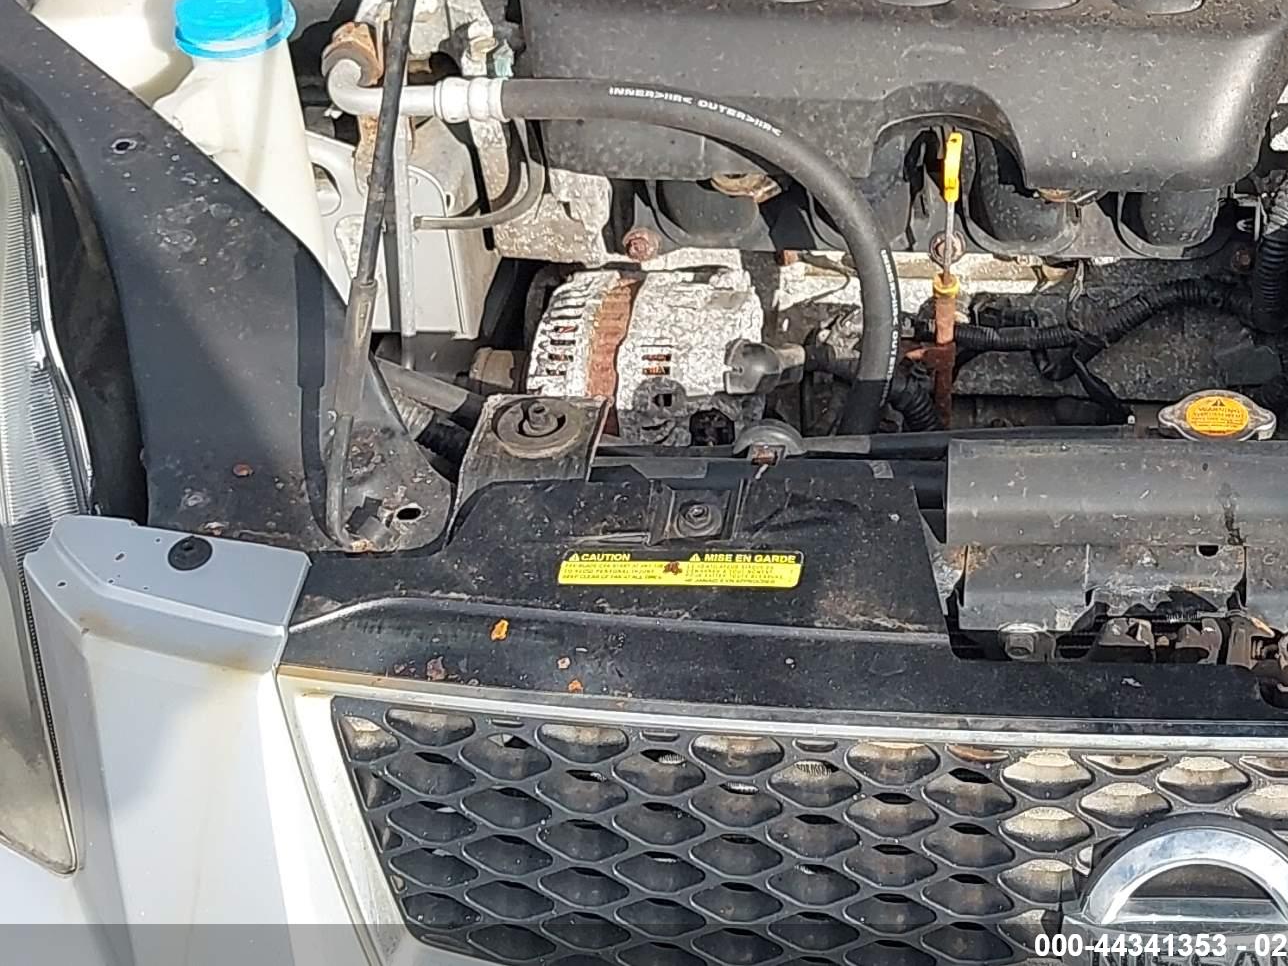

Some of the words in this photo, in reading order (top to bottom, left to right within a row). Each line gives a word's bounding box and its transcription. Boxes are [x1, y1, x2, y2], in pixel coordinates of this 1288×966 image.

[580, 553, 631, 562] CAUTION
[704, 553, 733, 562] MISE
[735, 554, 752, 563] EN
[754, 554, 796, 564] GARDE
